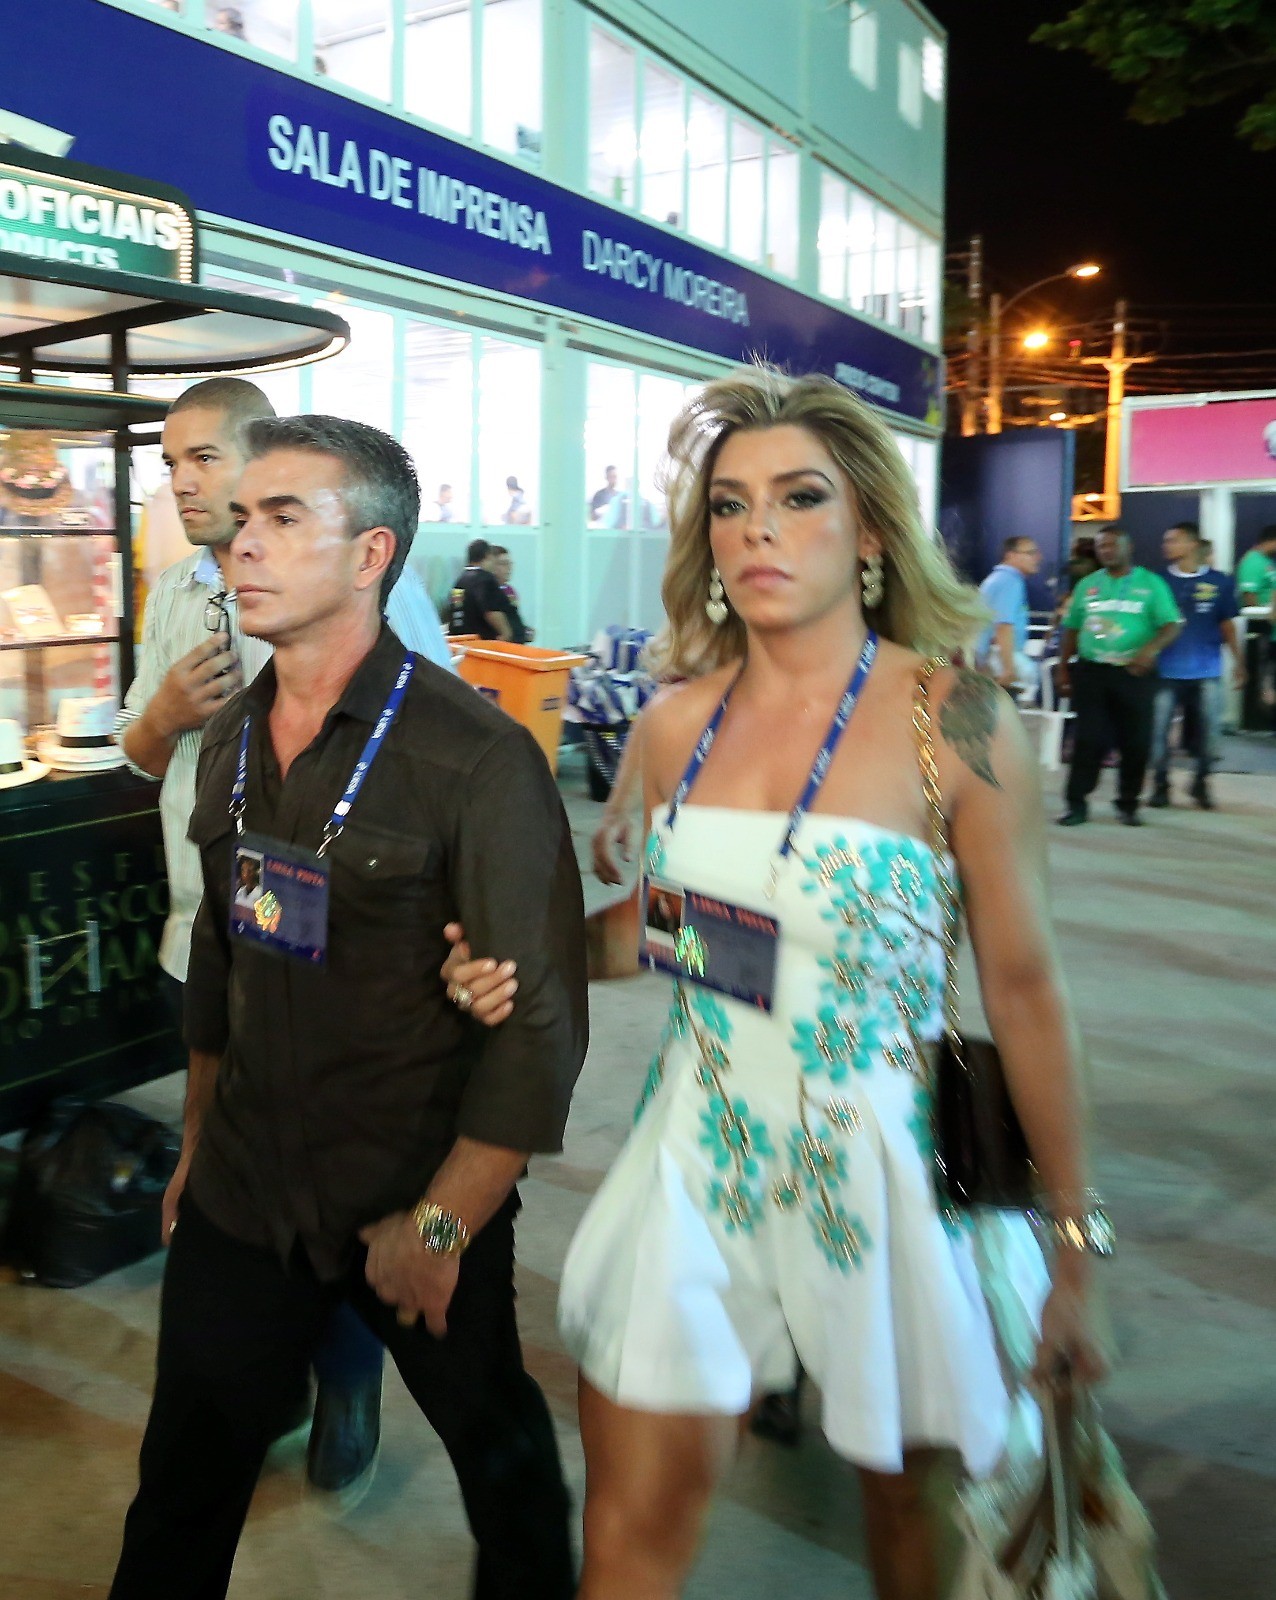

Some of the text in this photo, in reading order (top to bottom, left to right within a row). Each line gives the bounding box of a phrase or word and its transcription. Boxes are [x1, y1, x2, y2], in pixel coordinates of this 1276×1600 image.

[0, 178, 182, 251] OFICIAIS
[267, 114, 552, 255] SALA DE IMPRENSA
[582, 229, 750, 327] DARCY MOREIRA
